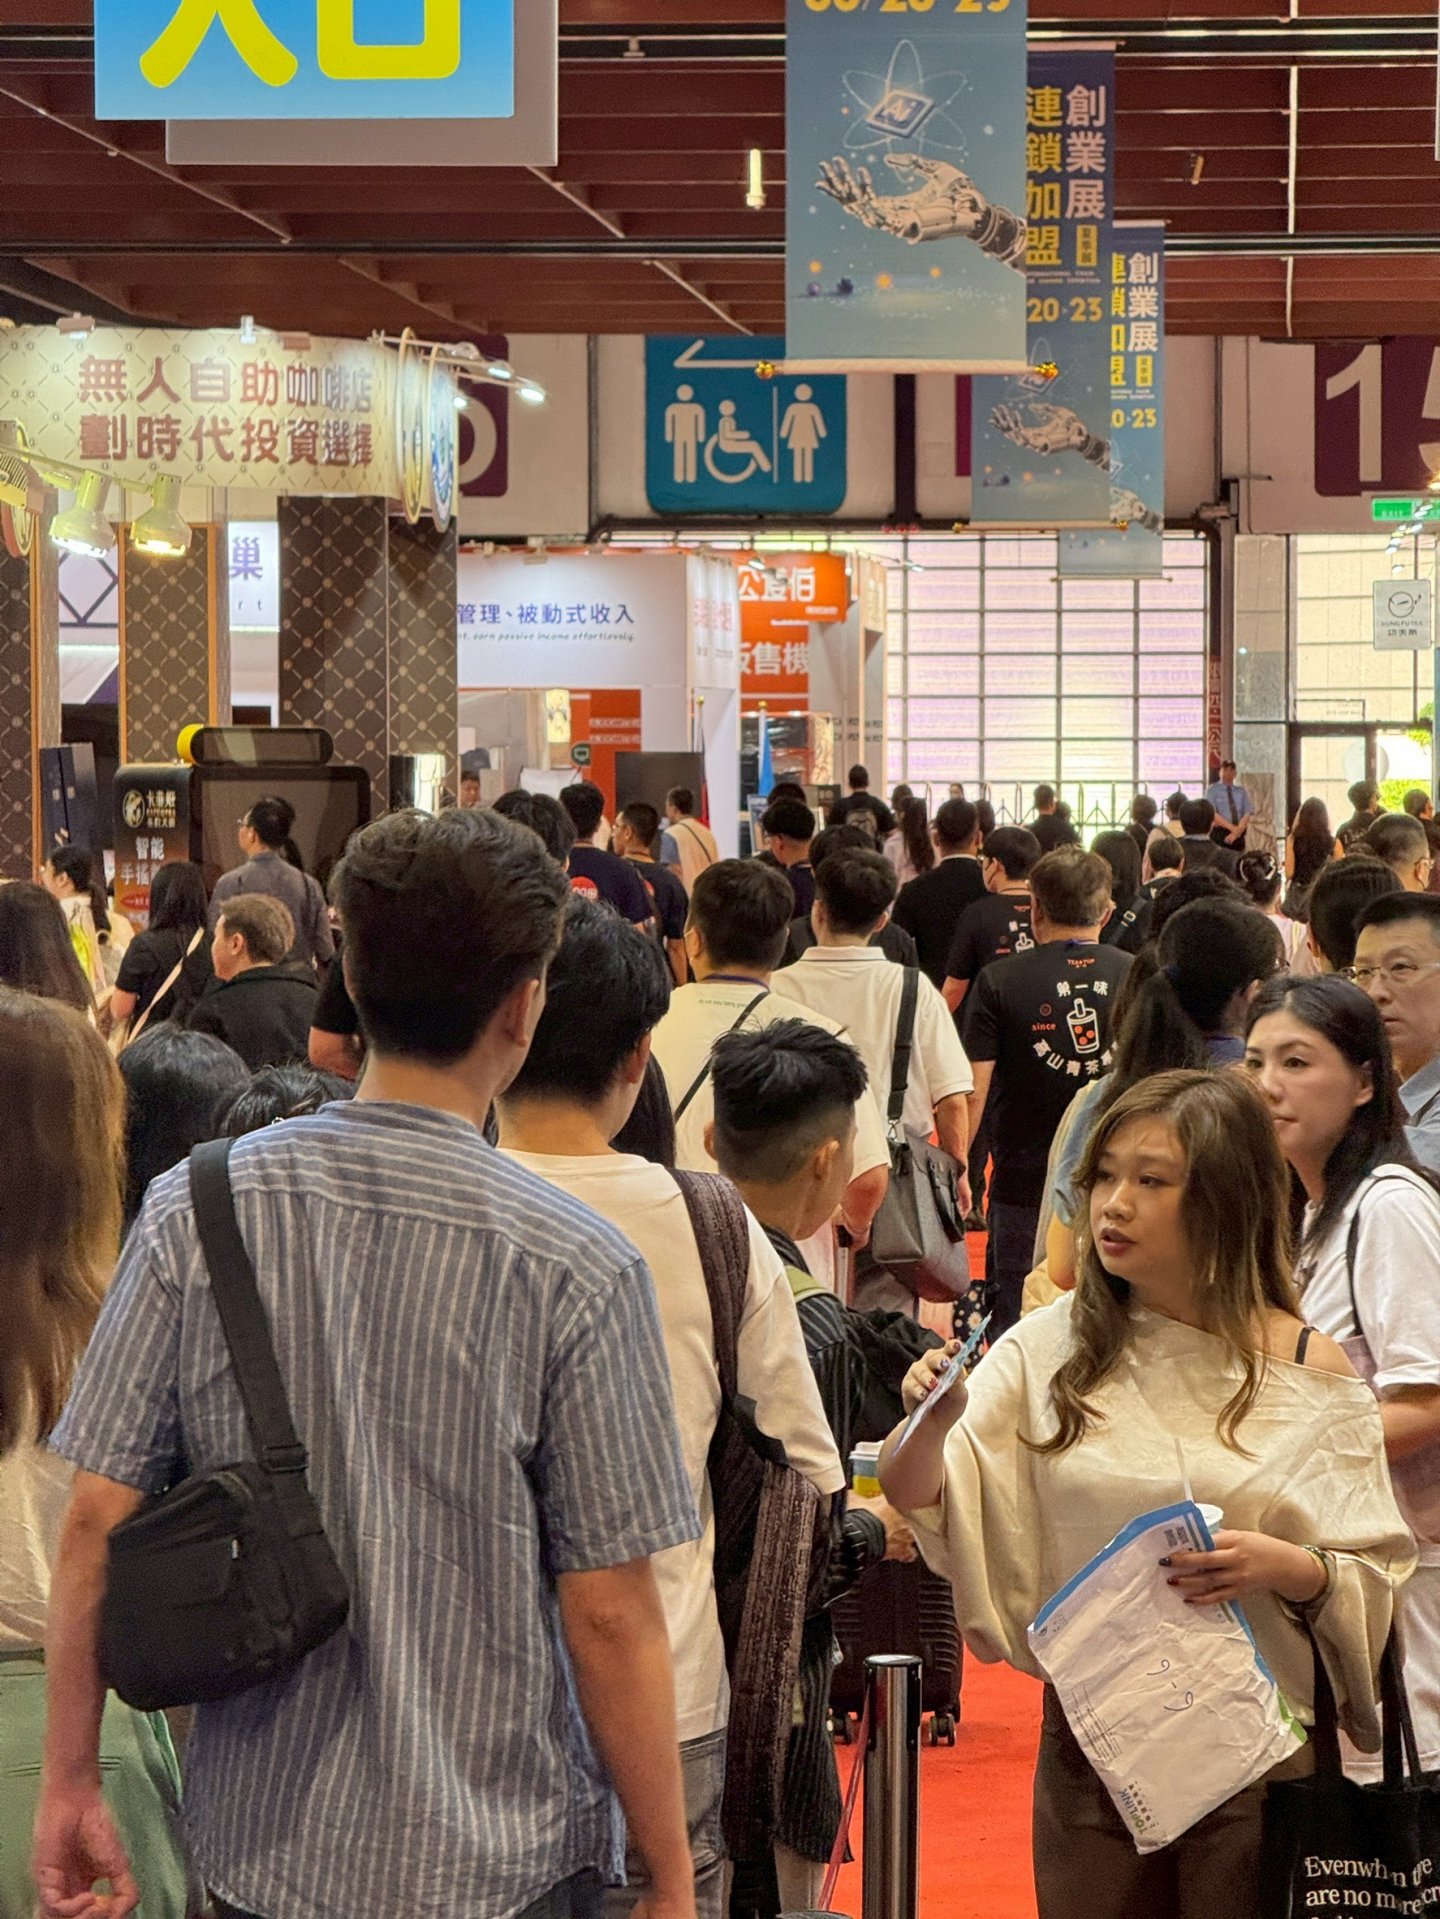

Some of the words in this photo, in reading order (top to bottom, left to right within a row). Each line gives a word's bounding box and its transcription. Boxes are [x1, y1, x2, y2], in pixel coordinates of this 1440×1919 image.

[1026, 85, 1062, 265] 連鎖加盟
[1065, 85, 1106, 220] 創業展
[1128, 252, 1159, 352] 創業展
[79, 355, 372, 413] 無人自助咖啡店
[79, 413, 372, 467] 劃時代投資選擇
[457, 603, 634, 625] 管理、被動式收入
[1032, 1022, 1056, 1031] since
[1306, 1889, 1340, 1907] are
[1343, 1889, 1371, 1906] no
